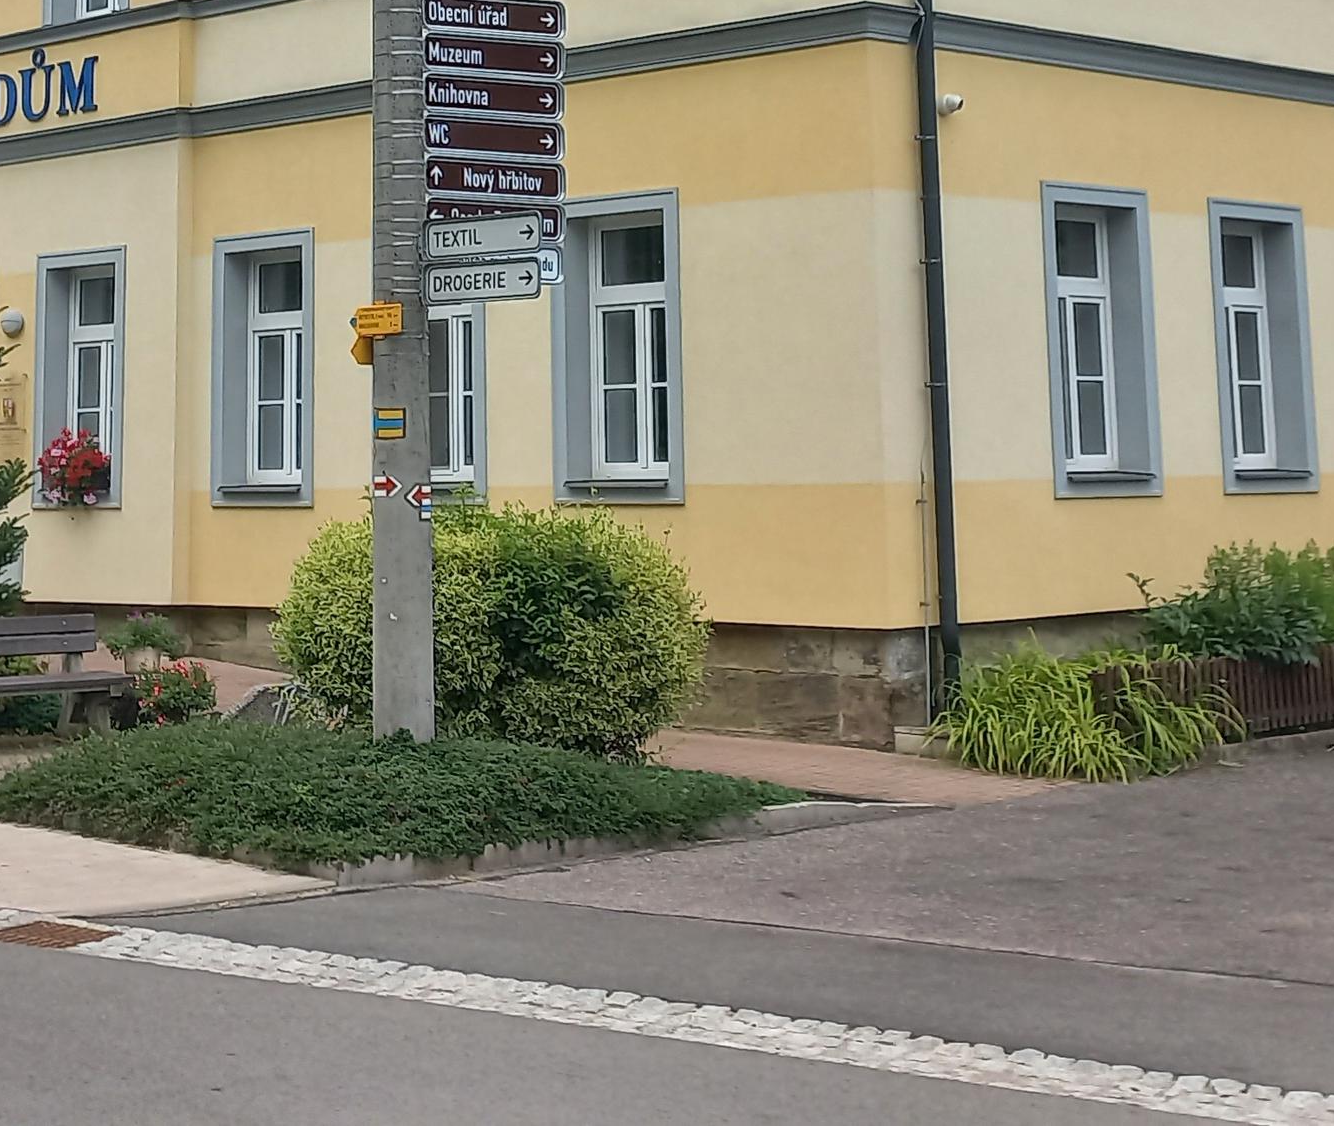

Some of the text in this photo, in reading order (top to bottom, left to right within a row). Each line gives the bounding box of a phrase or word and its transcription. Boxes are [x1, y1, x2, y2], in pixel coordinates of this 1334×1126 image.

[428, 0, 508, 27] Obecní úřad
[428, 42, 483, 65] Muzeum
[428, 81, 489, 107] Knihovna
[428, 123, 449, 145] WC
[463, 167, 543, 192] Nový hřbitov
[433, 228, 482, 249] TEXTIL
[433, 270, 507, 294] DROGERIE
